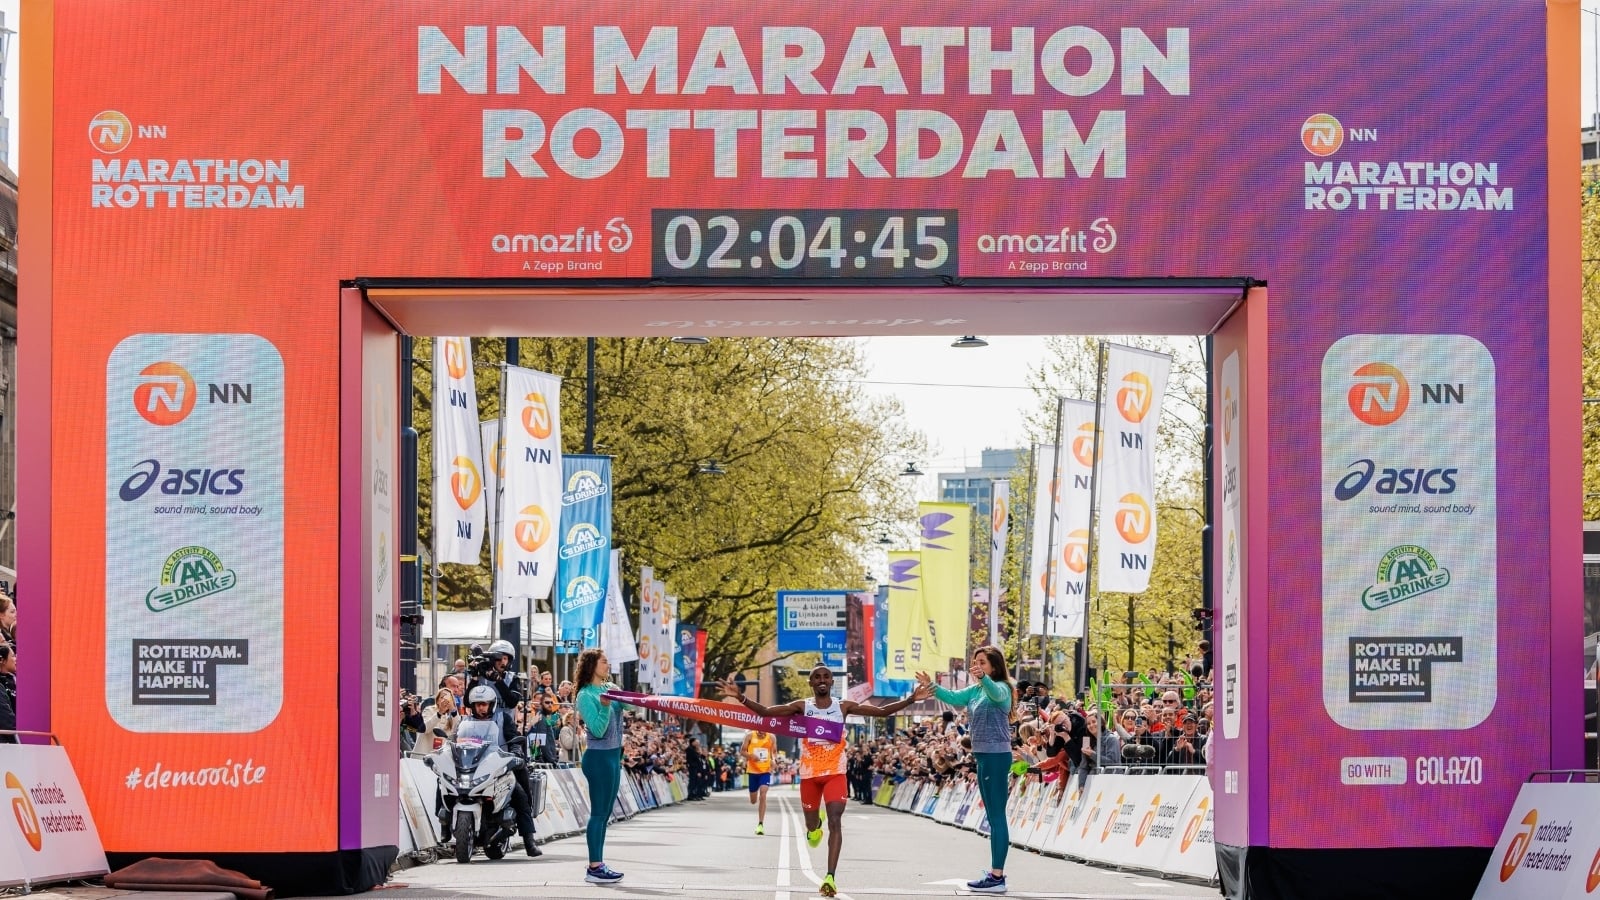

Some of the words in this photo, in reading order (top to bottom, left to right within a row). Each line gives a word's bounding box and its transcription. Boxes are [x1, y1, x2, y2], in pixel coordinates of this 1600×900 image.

[418, 25, 566, 95] NN
[593, 25, 1190, 97] MARATHON
[138, 125, 167, 139] NN
[482, 107, 1126, 180] ROTTERDAM
[1350, 128, 1378, 142] NN
[91, 158, 289, 183] MARATHON
[1304, 161, 1498, 186] MARATHON
[91, 184, 305, 208] ROTTERDAM
[1304, 187, 1514, 211] ROTTERDAM
[491, 226, 603, 253] amazfit
[664, 214, 949, 270] 02:04:45
[977, 227, 1088, 253] amazfit
[522, 260, 531, 271] A
[534, 260, 564, 273] Zepp
[567, 259, 603, 271] Brand
[1008, 260, 1016, 271] A
[1019, 260, 1049, 273] Zepp
[1052, 260, 1087, 271] Brand
[208, 383, 252, 404] NN
[1421, 383, 1464, 404] NN
[525, 447, 551, 465] NN
[161, 468, 245, 495] asics
[1075, 474, 1091, 490] N
[1375, 468, 1458, 494] asics
[154, 504, 182, 514] sound
[183, 504, 208, 516] mind,
[209, 504, 238, 514] sound
[239, 504, 262, 516] body
[1369, 503, 1397, 513] sound
[1398, 503, 1422, 515] mind,
[1423, 503, 1451, 513] sound
[1452, 503, 1475, 515] body
[179, 559, 213, 587] AA
[517, 560, 539, 577] NN
[1120, 553, 1147, 571] NN
[1394, 558, 1428, 585] AA
[173, 577, 222, 602] DRINK
[1388, 575, 1435, 601] DRINK
[138, 645, 242, 659] ROTTERDAM.
[826, 642, 843, 651] Ring
[1355, 643, 1456, 657] ROTTERDAM.
[138, 660, 186, 674] MAKE
[192, 660, 207, 674] IT
[1355, 658, 1401, 672] MAKE
[1407, 658, 1422, 672] IT
[138, 675, 210, 689] HAPPEN.
[1355, 673, 1425, 687] HAPPEN.
[657, 699, 671, 709] NN
[672, 700, 717, 716] MARATHON
[719, 709, 764, 725] ROTTERDAM
[125, 758, 267, 790] #demooiste
[1347, 764, 1362, 778] GO
[1364, 764, 1391, 778] WITH
[1415, 756, 1482, 785] GOLAZO
[31, 781, 66, 805] nationale
[41, 809, 88, 833] nederlanden
[1534, 819, 1573, 843] nationale
[1522, 847, 1572, 872] nederlanden
